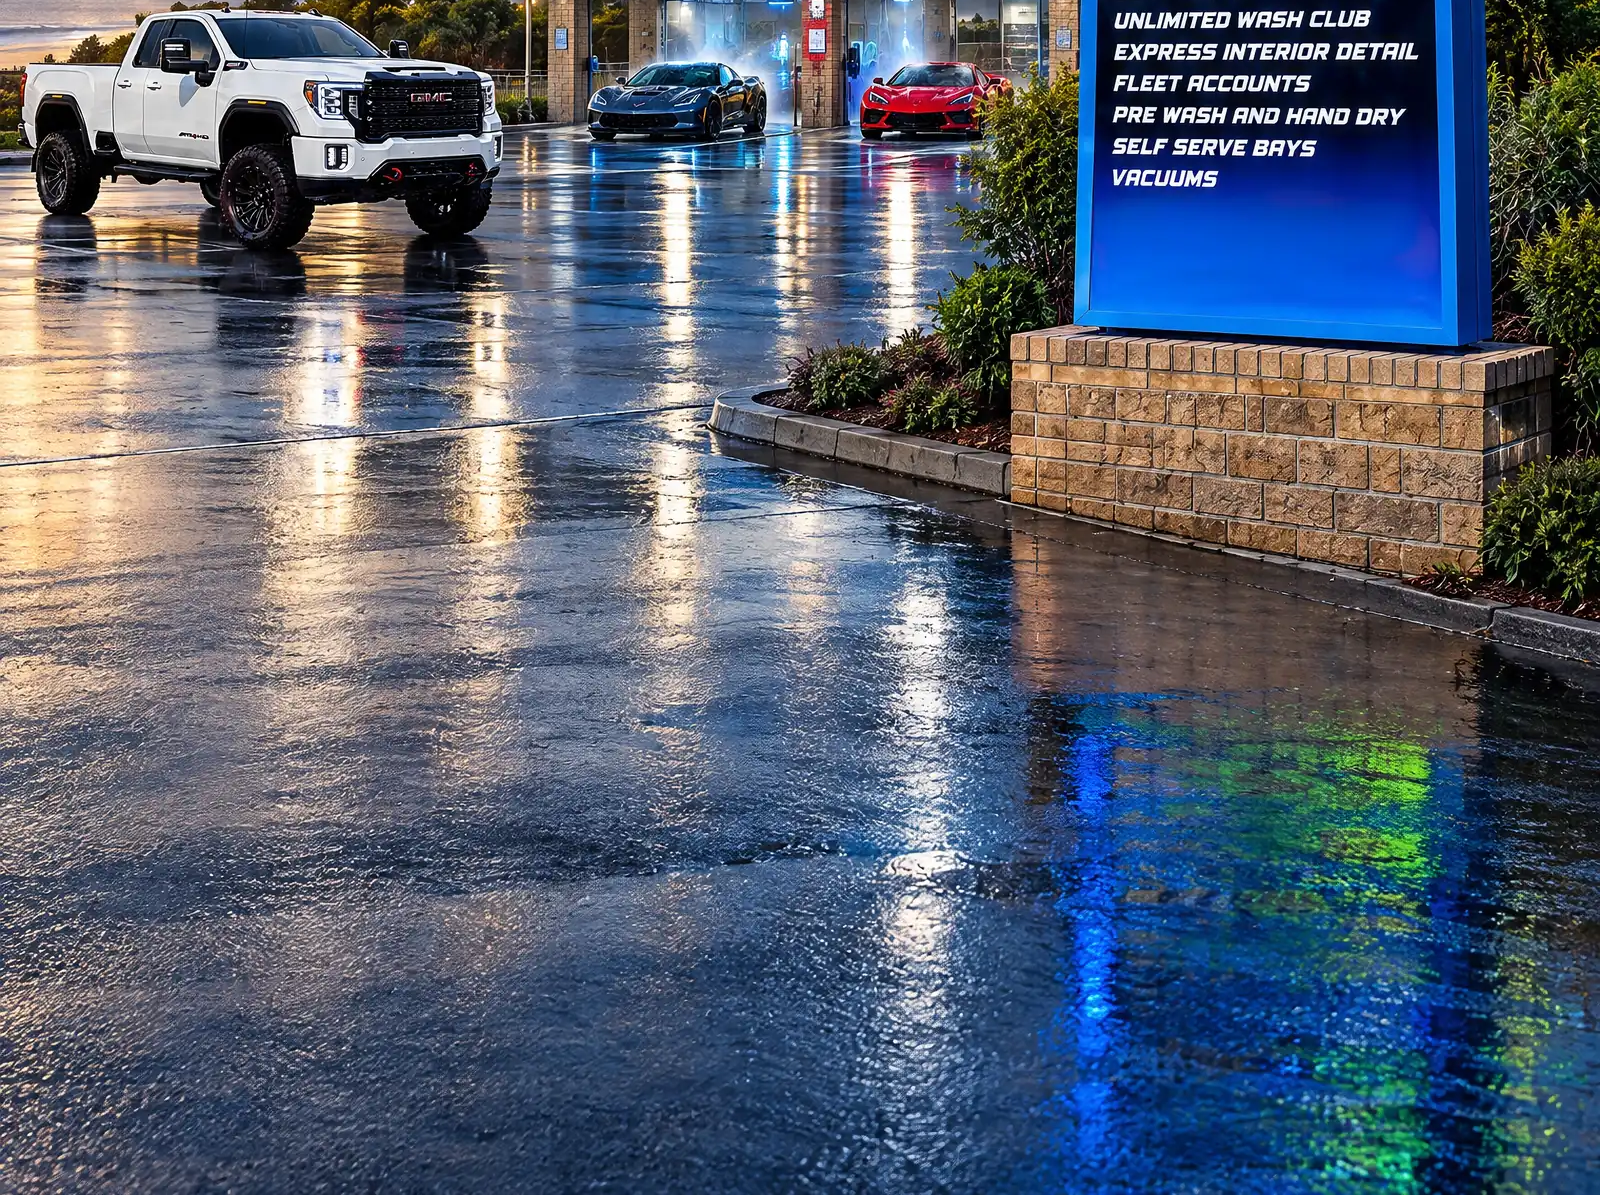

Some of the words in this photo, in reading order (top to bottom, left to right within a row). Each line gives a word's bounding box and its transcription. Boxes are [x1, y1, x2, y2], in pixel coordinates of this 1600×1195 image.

[1115, 12, 1231, 29] UNLIMITED
[1238, 11, 1304, 28] WASH
[1309, 10, 1371, 27] CLUB
[1114, 44, 1218, 60] EXPRESS
[1223, 43, 1330, 60] INTERIOR
[1336, 43, 1418, 60] DETAIL
[1114, 75, 1183, 91] FLEET
[1187, 75, 1311, 92] ACCOUNTS
[410, 92, 453, 102] GMC
[1113, 106, 1157, 123] PRE
[1164, 107, 1227, 123] WASH
[1232, 108, 1280, 124] AND
[1285, 108, 1350, 124] HAND
[1356, 108, 1406, 125] DRY
[1112, 138, 1168, 155] SELF
[1172, 139, 1248, 156] SERVE
[1252, 140, 1317, 157] BAYS
[1113, 169, 1218, 187] VACUUMS
